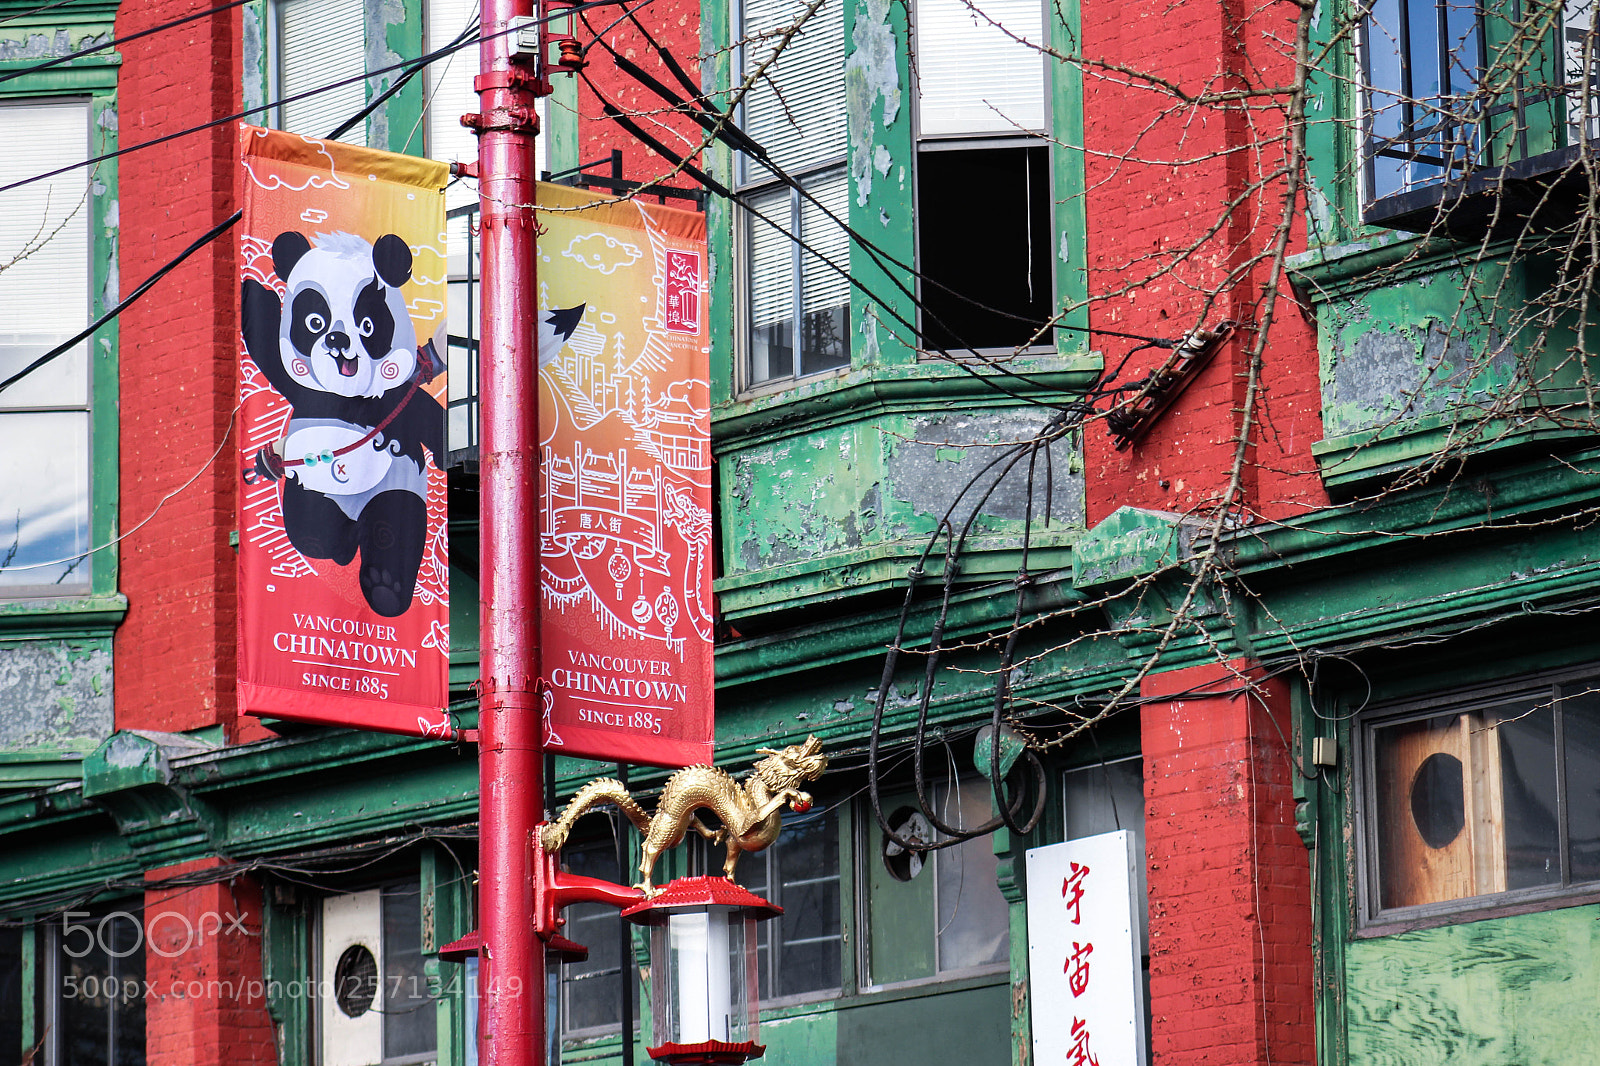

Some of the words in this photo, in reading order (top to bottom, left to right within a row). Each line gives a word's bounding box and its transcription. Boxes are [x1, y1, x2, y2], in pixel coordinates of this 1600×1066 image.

[579, 513, 622, 534] 唐人街
[293, 613, 398, 642] VANCOUVER
[273, 632, 417, 668] CHINATOWN
[568, 650, 672, 676] VANCOUVER
[302, 672, 351, 691] SINCE
[355, 676, 389, 699] 1885
[551, 668, 687, 704] CHINATOWN
[578, 708, 624, 727] SINCE
[628, 711, 662, 735] 1885
